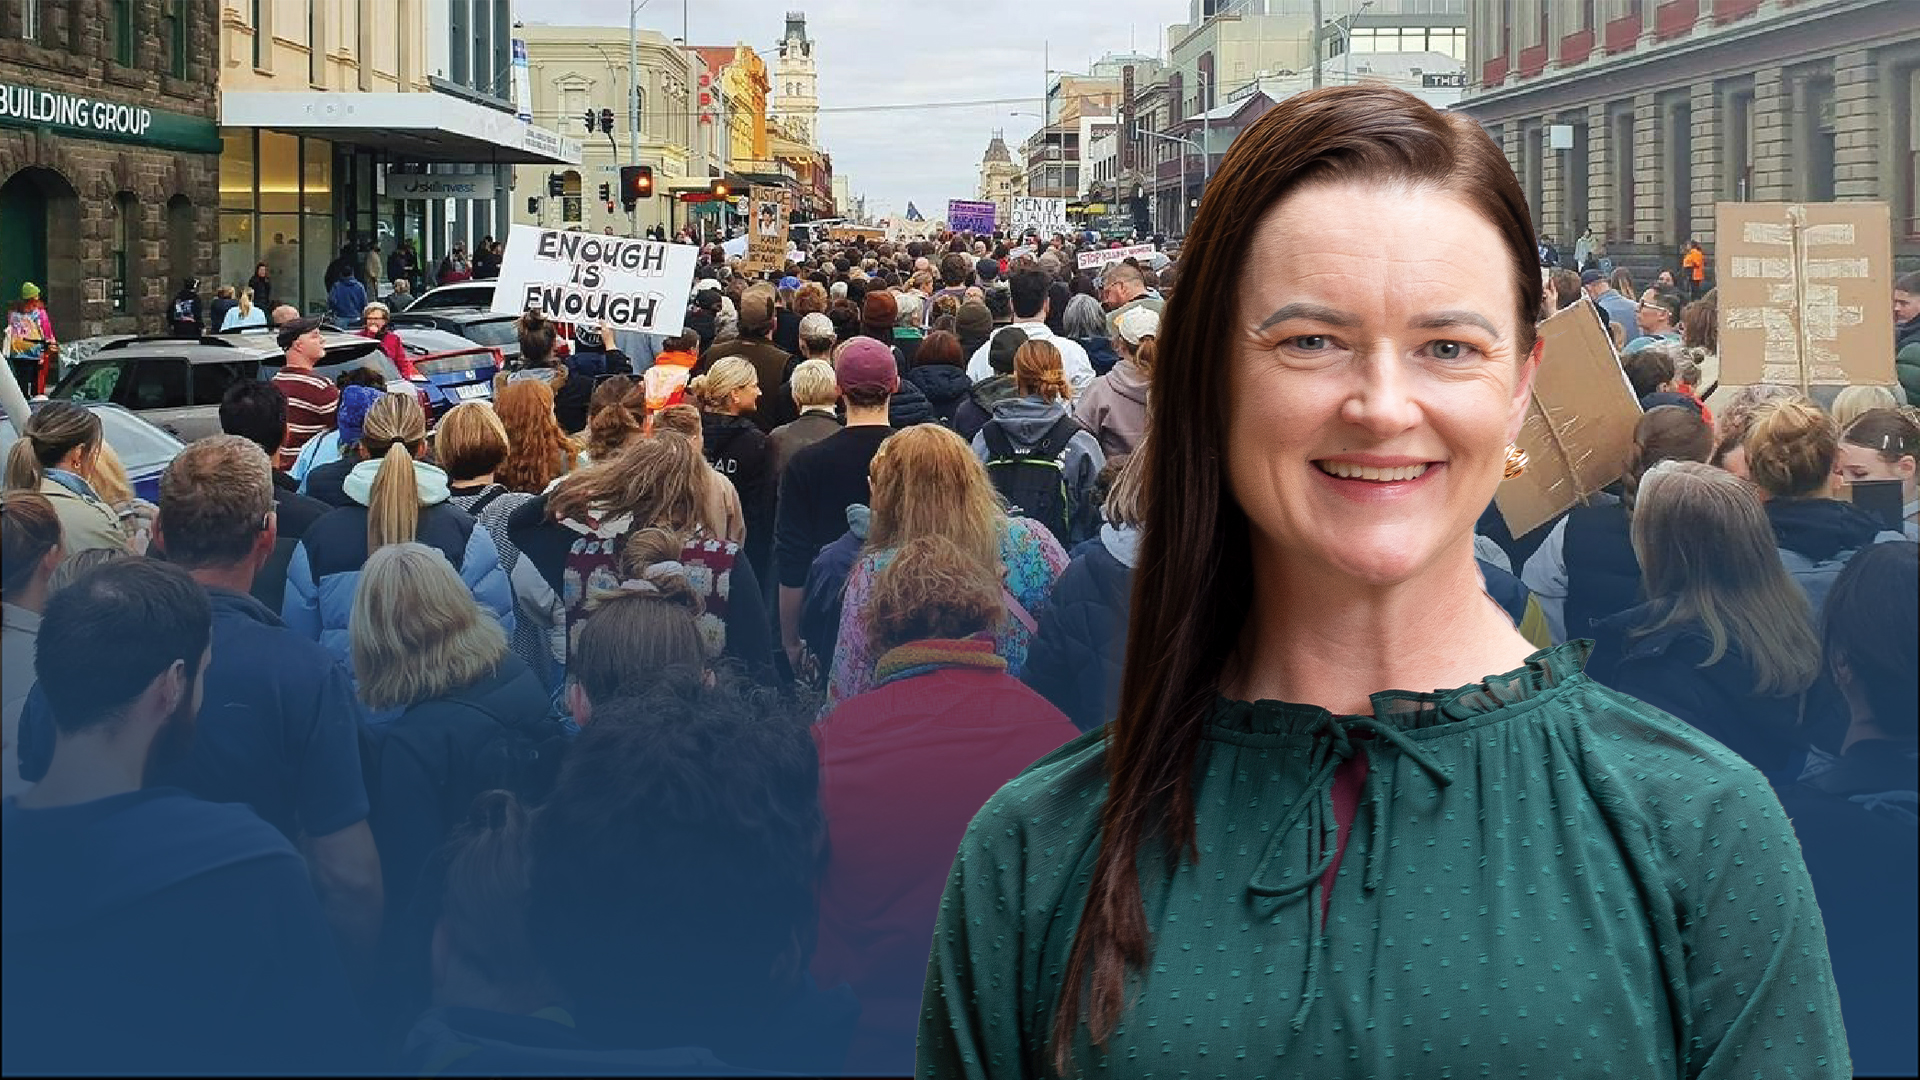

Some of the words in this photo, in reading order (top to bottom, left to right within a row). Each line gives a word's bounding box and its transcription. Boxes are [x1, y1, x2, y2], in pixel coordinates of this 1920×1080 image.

[0, 85, 89, 127] BUILDING
[92, 102, 152, 135] GROUP
[749, 187, 790, 206] JUSTICE
[1013, 198, 1042, 211] MEN
[1045, 199, 1064, 212] OF
[1012, 211, 1061, 224] QUALITY
[537, 231, 664, 271] ENOUGH
[1080, 253, 1100, 267] STOP
[571, 264, 600, 288] IS
[523, 286, 657, 328] ENOUGH
